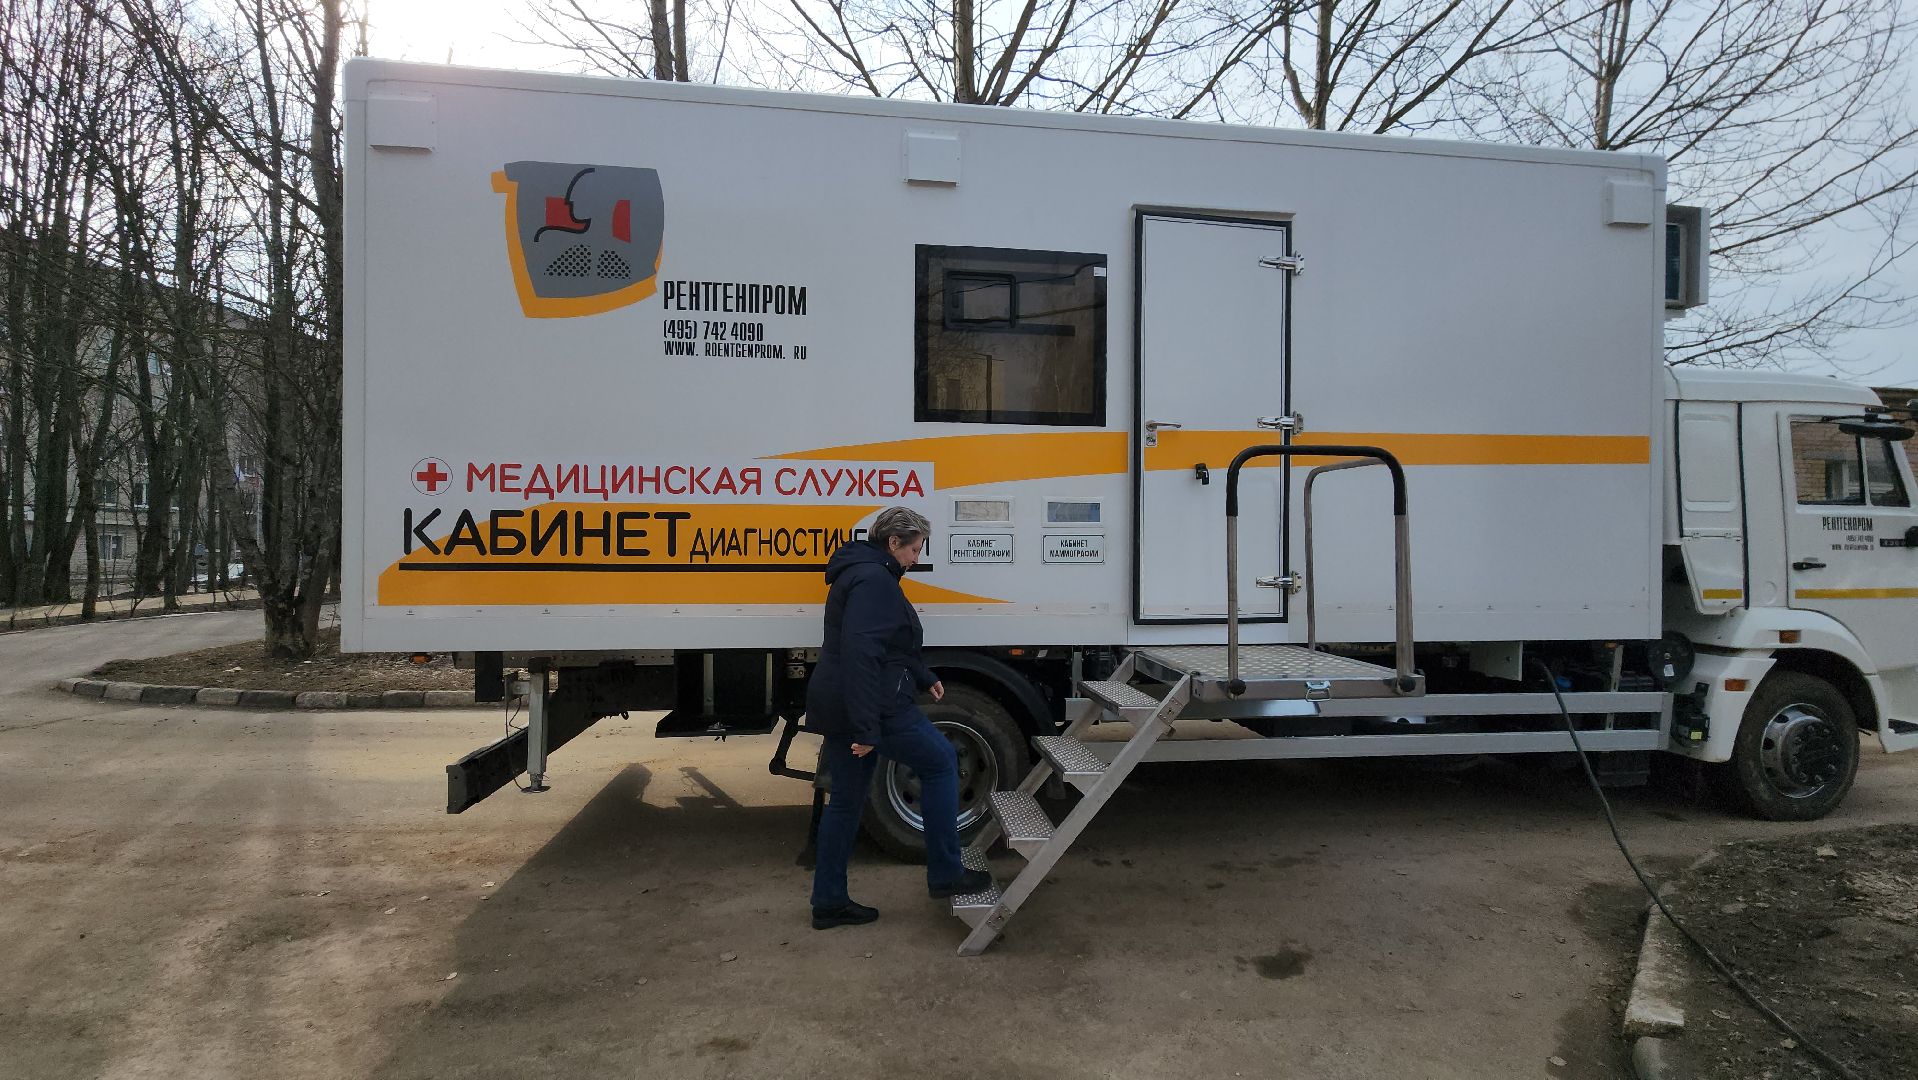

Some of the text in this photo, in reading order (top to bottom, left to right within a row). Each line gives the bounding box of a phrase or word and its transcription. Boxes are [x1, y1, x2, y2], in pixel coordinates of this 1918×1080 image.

[663, 280, 808, 316] РЕНТГЕНПРОМ
[663, 319, 764, 342] (495) 742 4090
[664, 341, 807, 360] WWW. ROENTGENPROM. RU
[466, 462, 925, 501] МЕДИЦИНСКАЯ СЛУЖБА
[403, 507, 691, 558] КАБИНЕТ
[953, 549, 1011, 558] РЕНТГЕНОГРАФИИ
[1049, 549, 1099, 558] МАММОГРАФИИ
[1060, 539, 1088, 548] КАБИНЕТ
